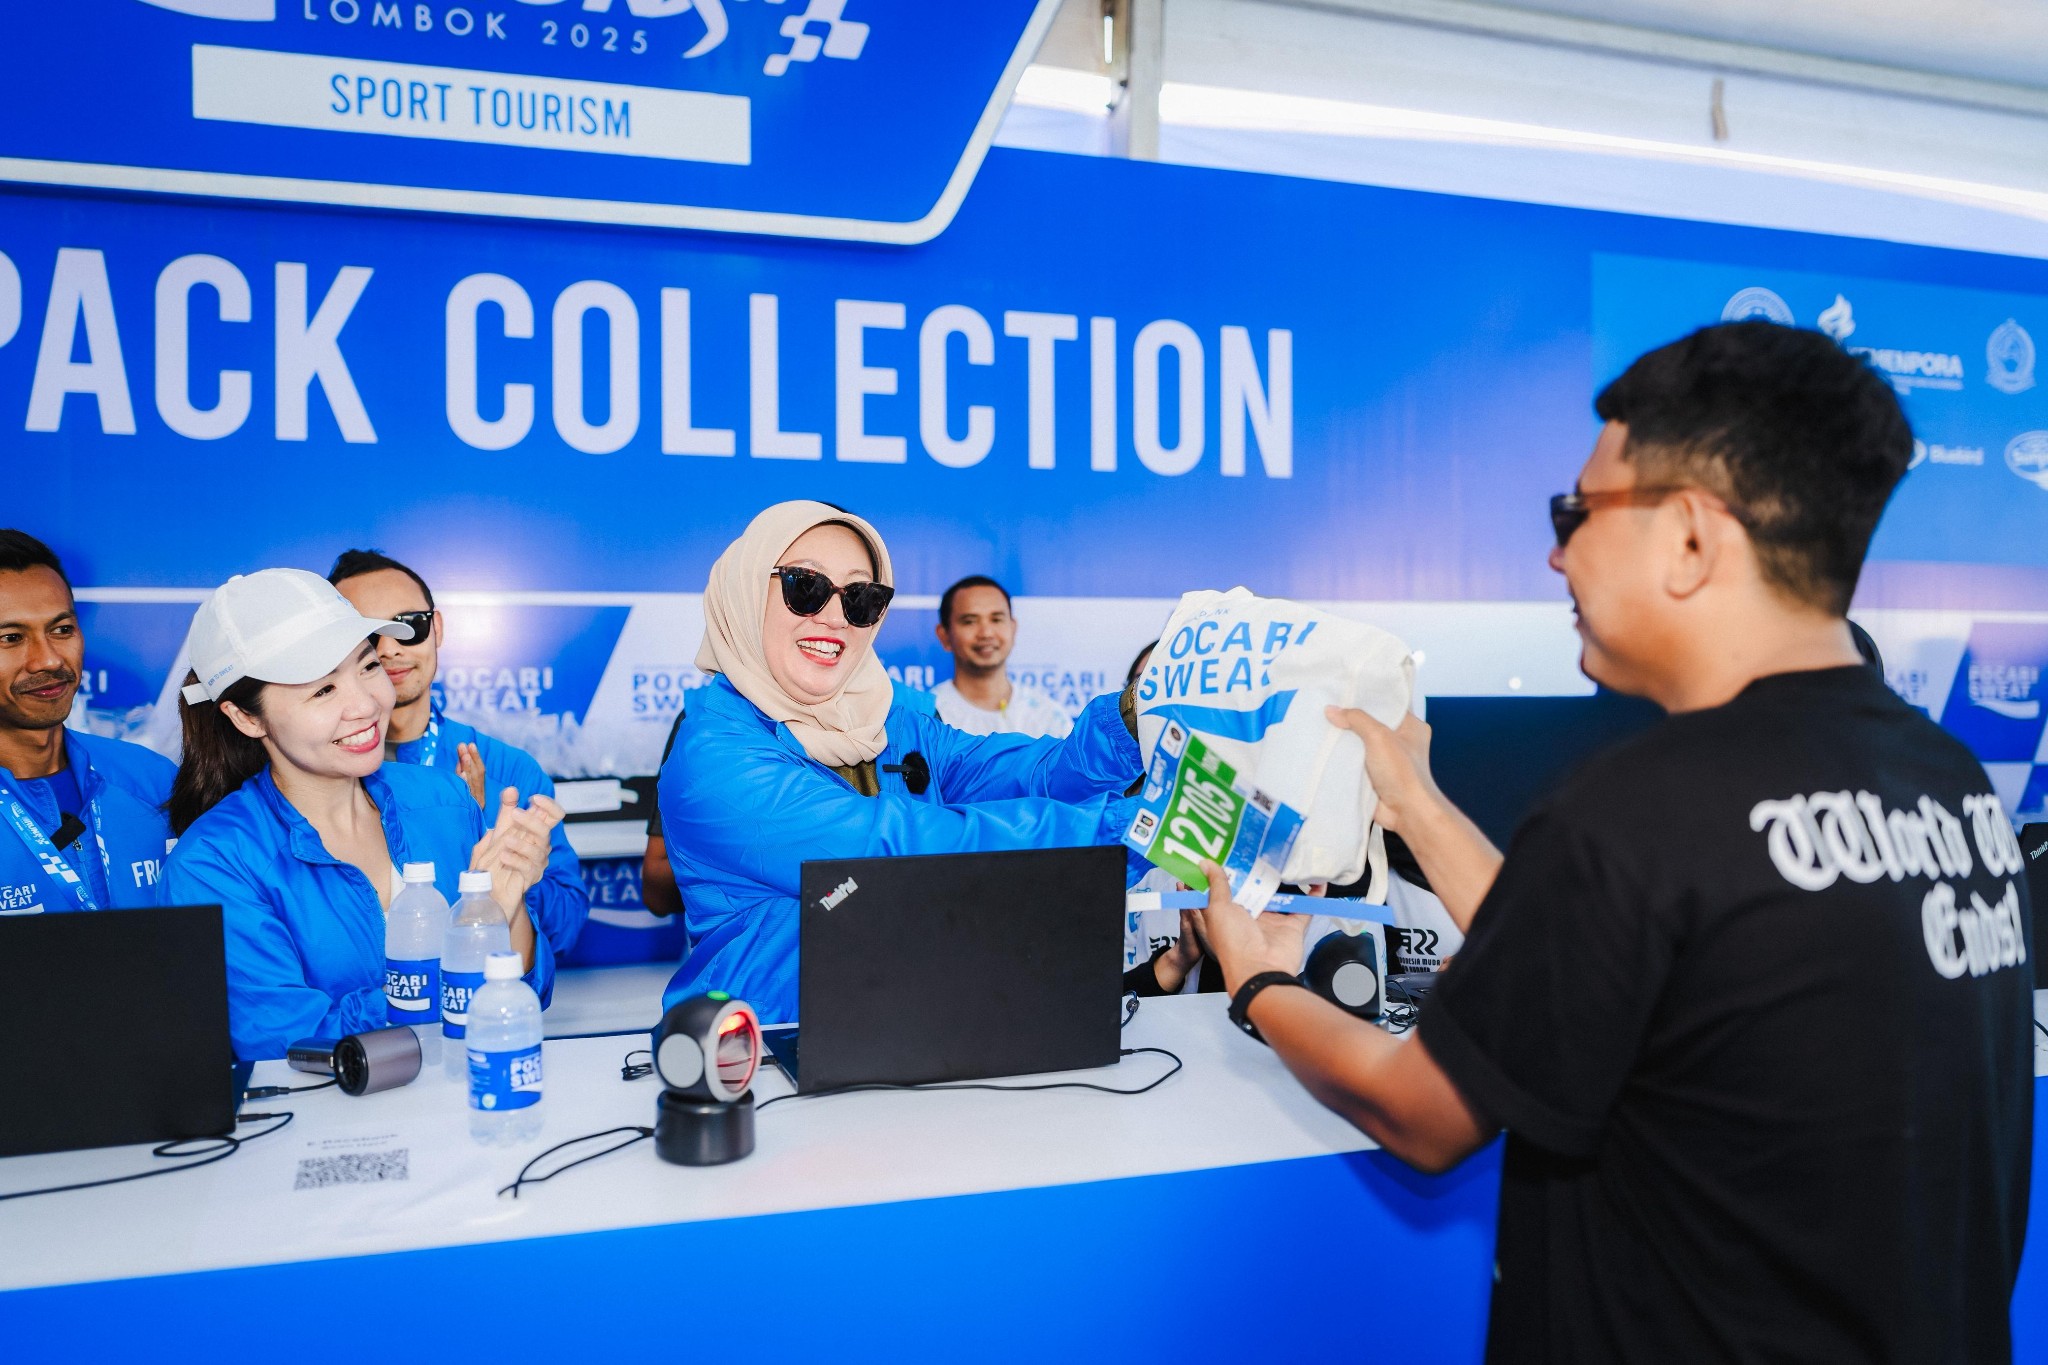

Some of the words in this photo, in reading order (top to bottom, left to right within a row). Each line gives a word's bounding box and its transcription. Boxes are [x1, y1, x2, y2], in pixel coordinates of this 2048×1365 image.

[303, 0, 507, 40] LOMBOK
[541, 21, 648, 54] 2025
[330, 73, 453, 122] SPORT
[469, 87, 632, 138] TOURISM
[0, 247, 378, 444] ACK
[446, 273, 1294, 479] COLLECTION
[1169, 621, 1318, 660] OCARI
[632, 673, 712, 691] POC
[887, 665, 935, 691] ARI
[1163, 767, 1236, 866] 12705
[131, 859, 160, 888] FRI
[0, 883, 37, 900] CARI
[0, 894, 33, 910] WEAT
[386, 973, 428, 986] OCARI
[386, 984, 422, 997] WEAT
[442, 986, 473, 999] CARI
[442, 997, 467, 1011] EAT
[510, 1055, 542, 1075] POC
